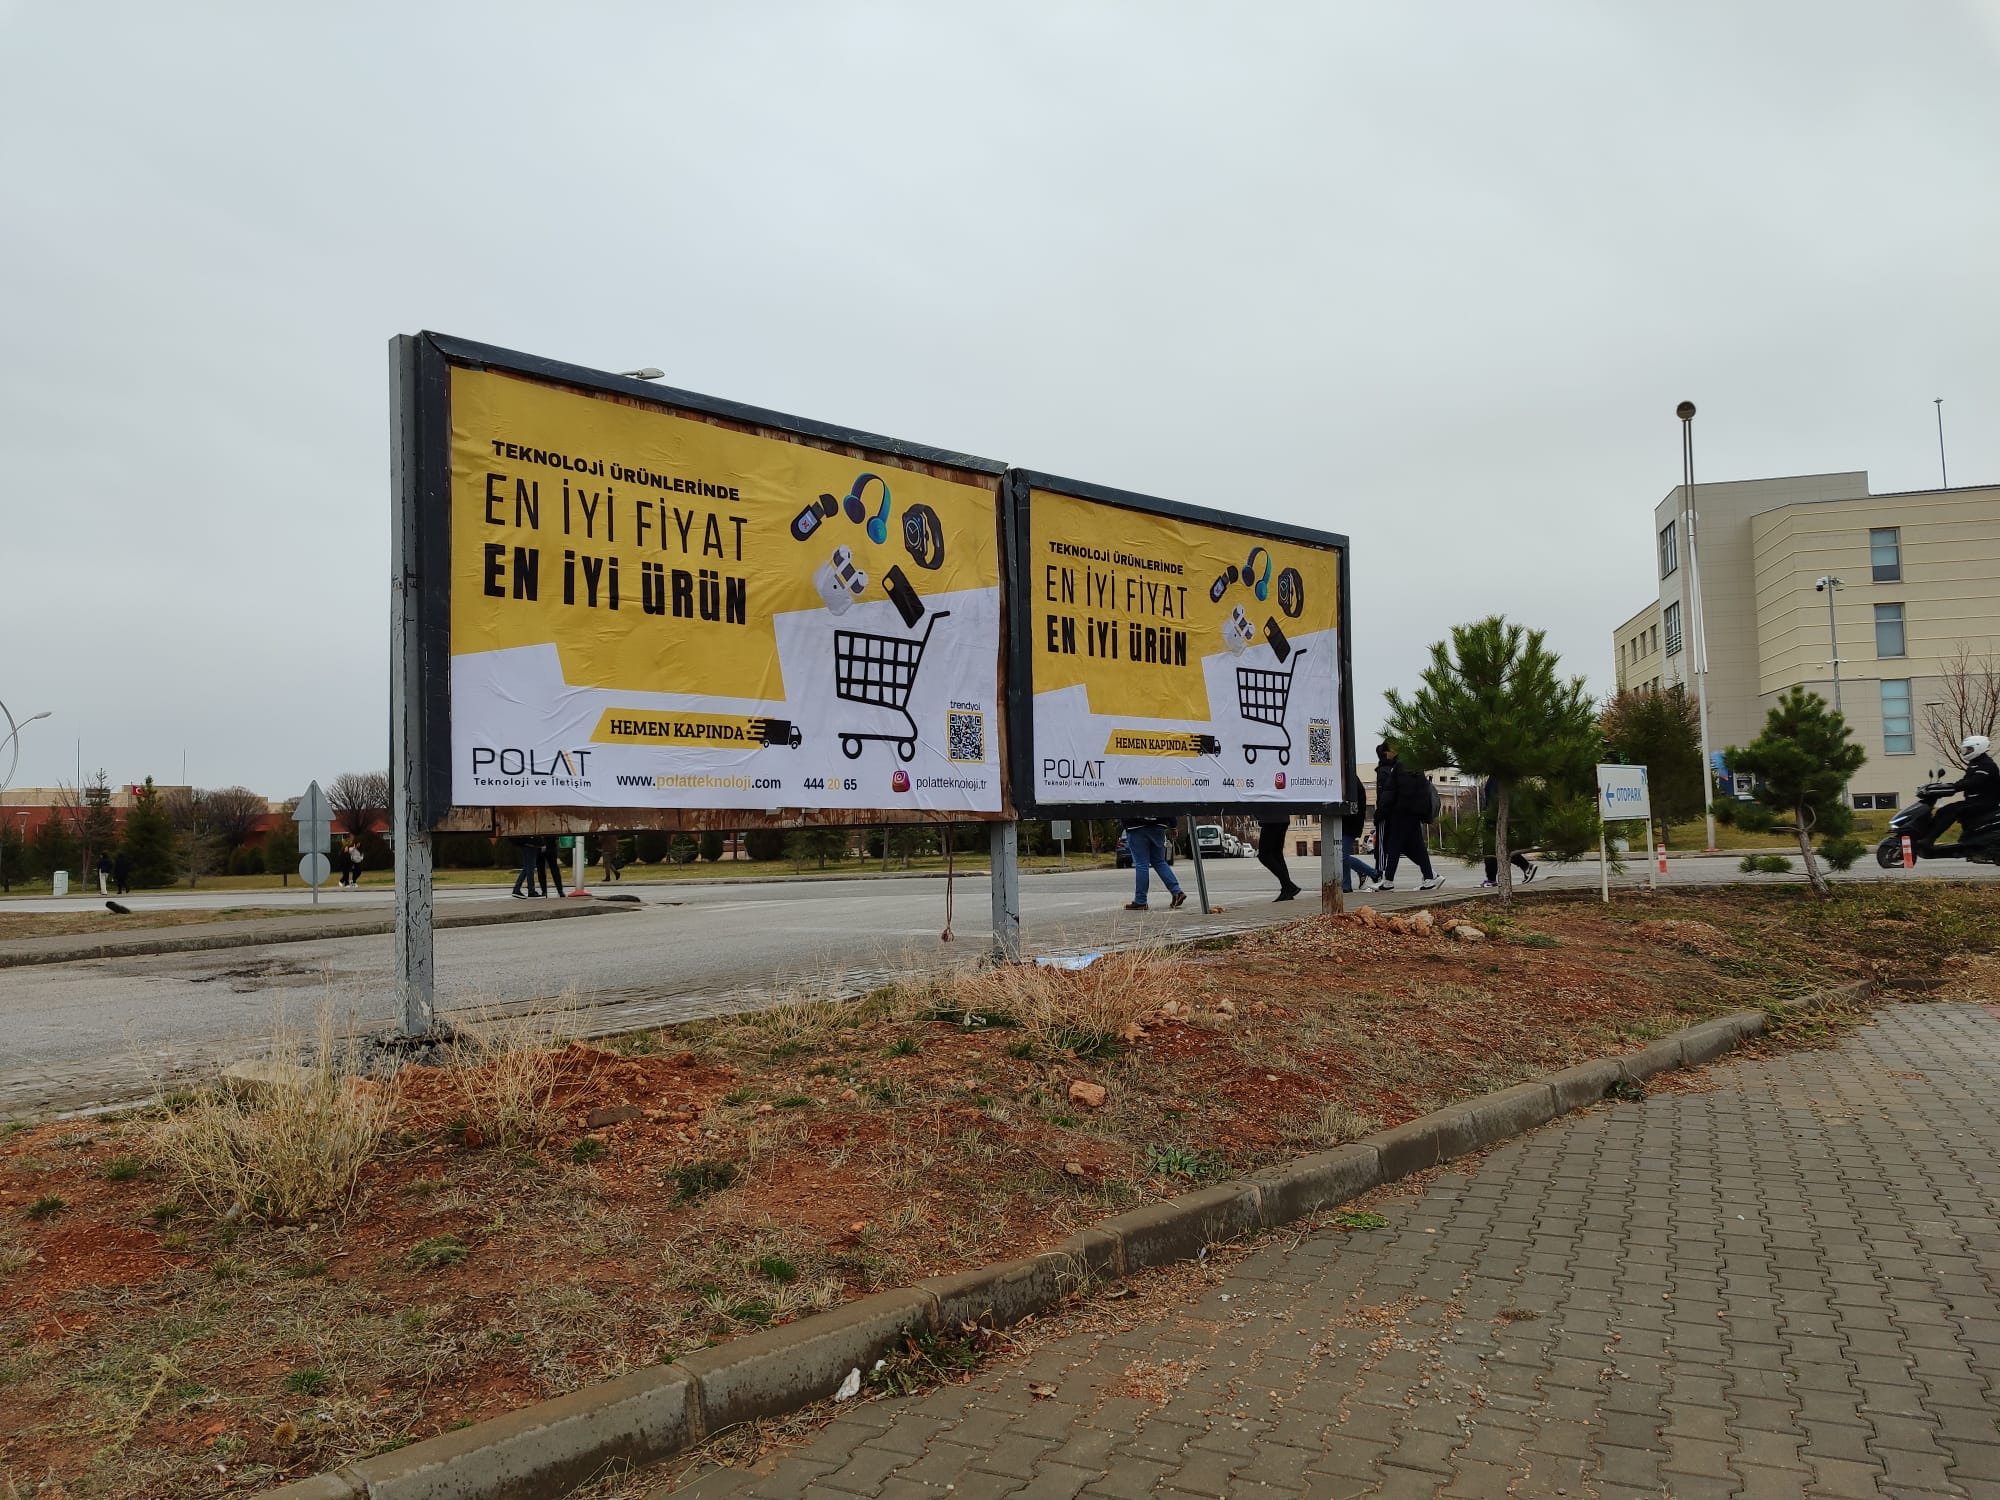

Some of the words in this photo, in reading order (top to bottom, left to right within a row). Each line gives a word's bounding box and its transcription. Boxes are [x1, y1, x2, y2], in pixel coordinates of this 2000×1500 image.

[491, 440, 604, 477] TEKNOLOJİ
[610, 463, 740, 501] ÜRÜNLERİNDE
[485, 472, 539, 530] EN
[563, 478, 614, 542] İYİ
[636, 497, 748, 561] FİYAT
[1049, 541, 1110, 562] TEKNOLOJİ
[1113, 550, 1184, 575] ÜRÜNLERİNDE
[484, 543, 539, 602] EN
[563, 549, 619, 611] İYİ
[641, 561, 746, 625] ÜRÜN
[1046, 565, 1074, 604] EN
[1086, 565, 1115, 610] İYİ
[1127, 574, 1187, 620] FİYAT
[1047, 614, 1076, 655] EN
[1088, 617, 1118, 659] İYİ
[1129, 622, 1187, 667] ÜRÜN
[610, 719, 670, 738] HEMEN
[674, 723, 745, 741] KAPINDA
[1115, 737, 1147, 750] HEMEN
[1148, 739, 1188, 751] KAPINDA
[472, 747, 591, 777] POLAT
[1043, 759, 1105, 779] POLAT
[474, 777, 530, 788] Teknoloji
[534, 779, 547, 787] ve
[616, 773, 782, 791] www.polatteknoloji.com
[803, 777, 825, 790] 444
[827, 778, 841, 791] 20
[843, 777, 857, 791] 65
[916, 777, 988, 792] polatteknoloji.tr
[1118, 776, 1210, 788] www.polatteknoloji.com
[1222, 777, 1235, 788] 444
[1236, 778, 1245, 788] 20
[1246, 779, 1255, 788] 65
[1616, 787, 1642, 801] OTOPARK
